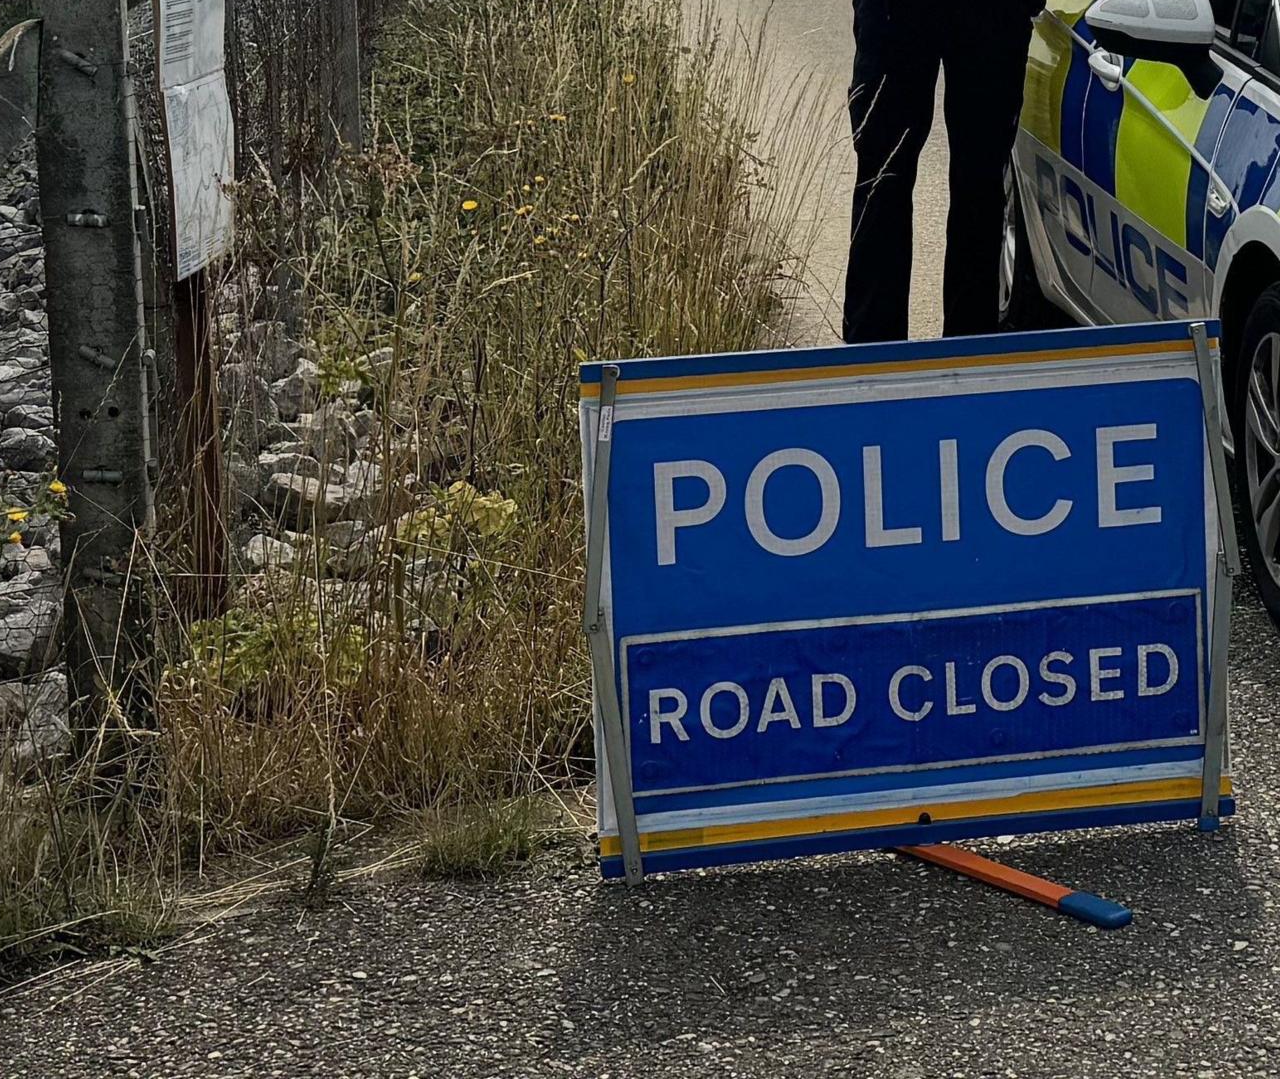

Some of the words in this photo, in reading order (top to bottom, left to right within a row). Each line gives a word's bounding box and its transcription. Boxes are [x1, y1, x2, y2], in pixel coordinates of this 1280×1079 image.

[1035, 153, 1189, 321] POLICE
[653, 423, 1162, 566] POLICE
[648, 673, 857, 744] ROAD
[888, 643, 1179, 722] CLOSED
